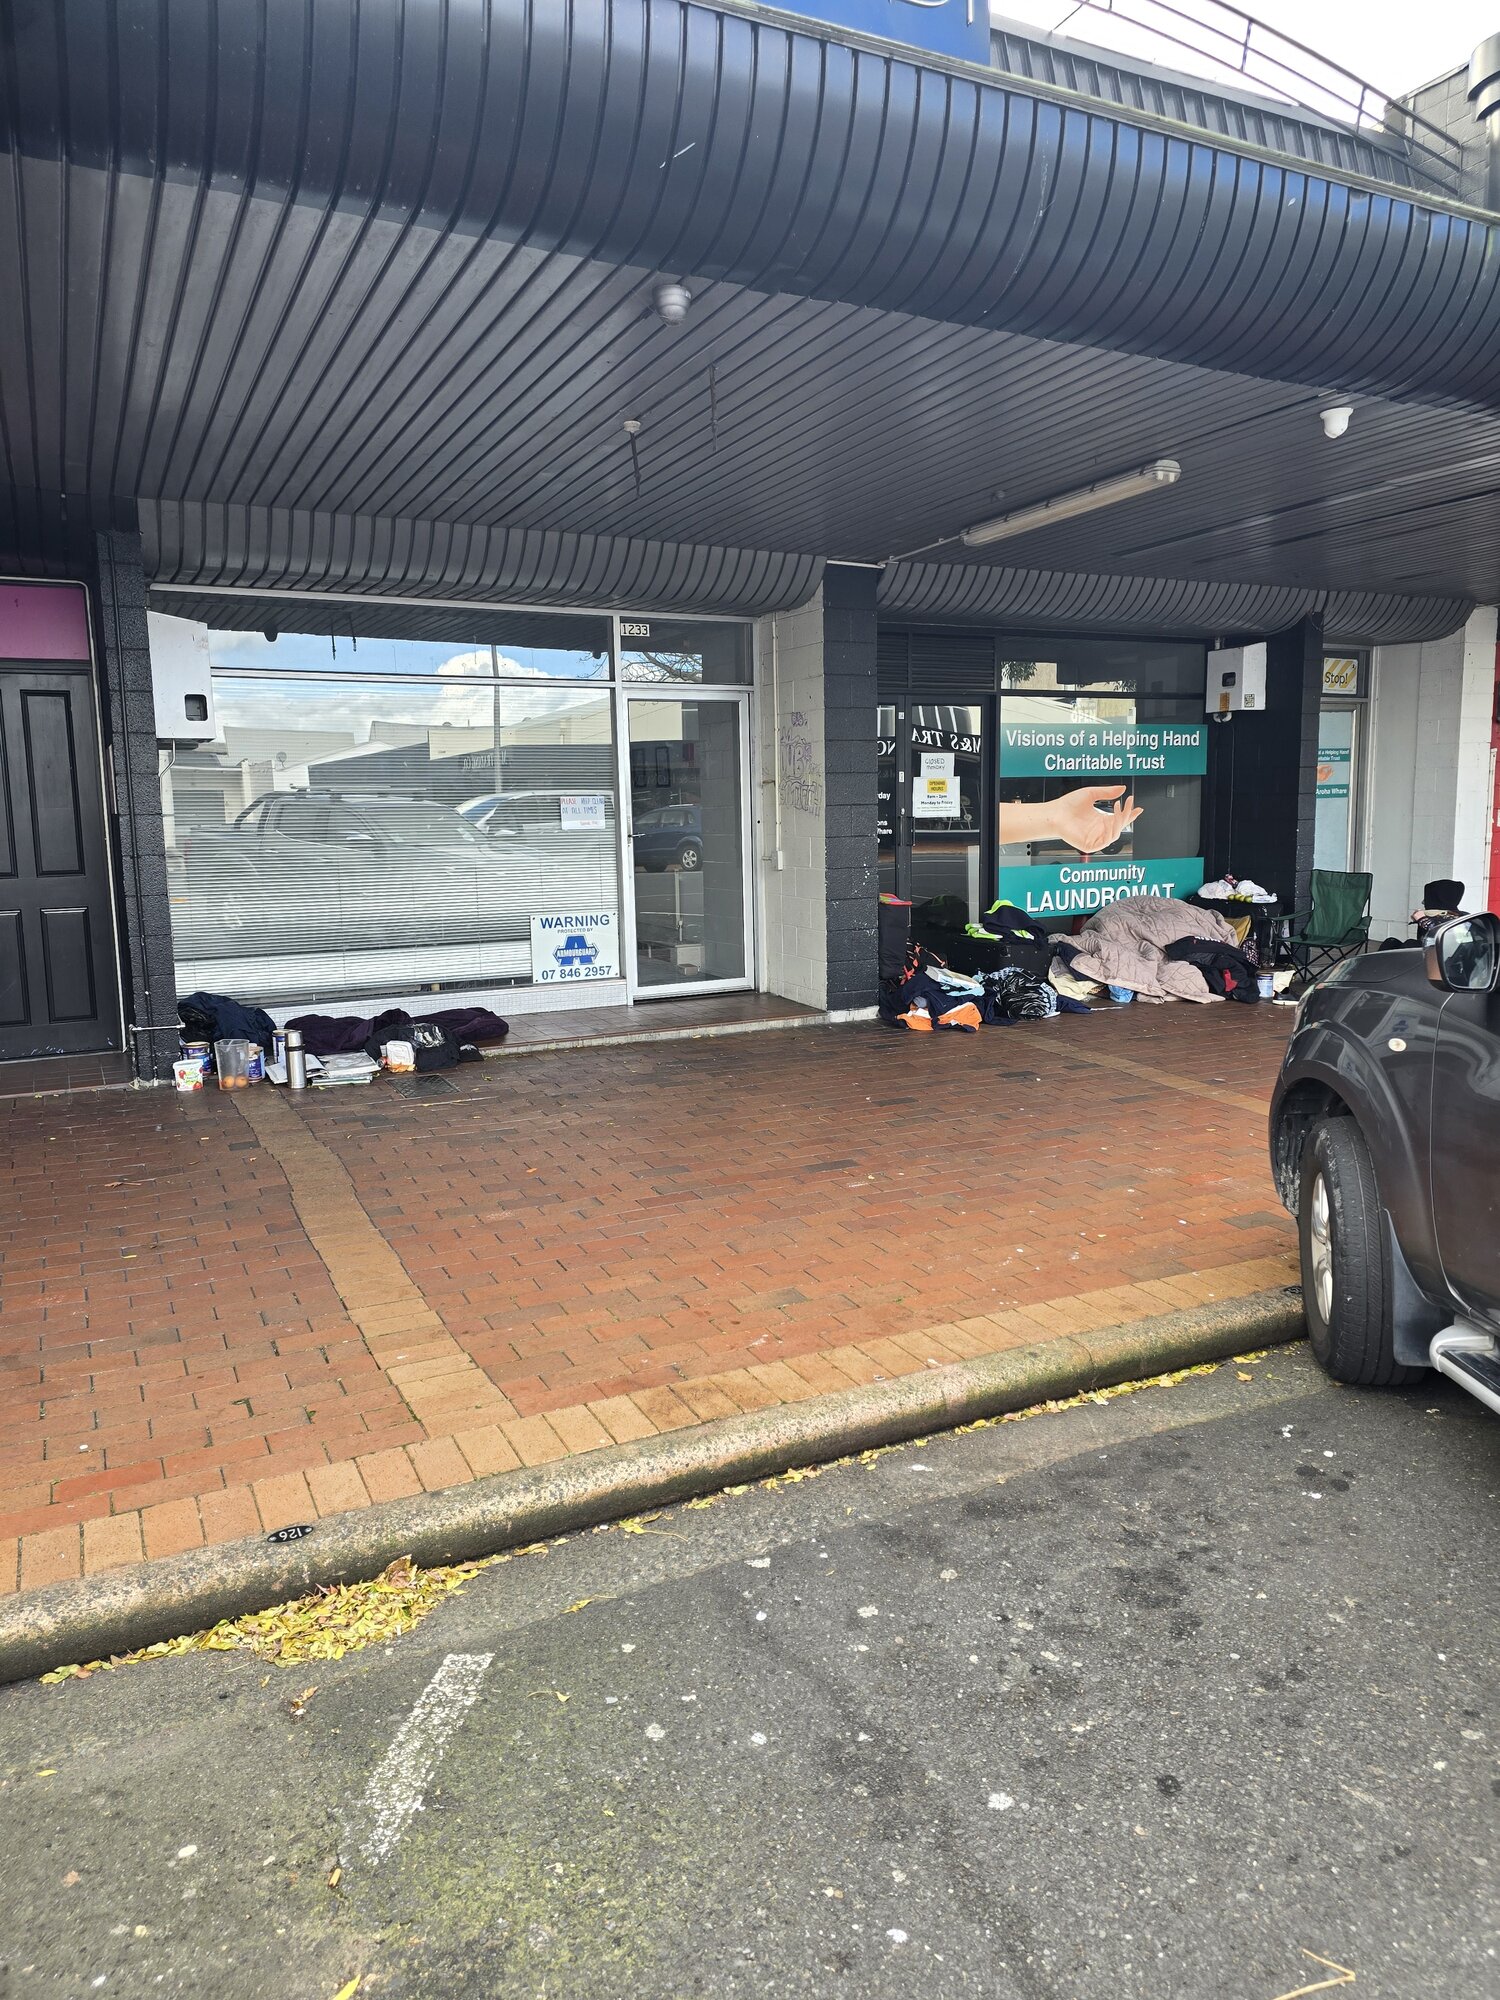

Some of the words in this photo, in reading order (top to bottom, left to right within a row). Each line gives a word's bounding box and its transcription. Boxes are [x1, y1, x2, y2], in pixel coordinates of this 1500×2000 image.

[622, 624, 648, 635] 1233
[1324, 671, 1348, 686] Stop!
[1006, 729, 1065, 747] Visions
[1069, 730, 1086, 747] of
[1089, 734, 1098, 747] a
[1102, 730, 1159, 751] Helping
[1163, 730, 1200, 747] Hand
[1044, 753, 1123, 771] Charitable
[1126, 753, 1165, 770] Trust
[1060, 864, 1146, 884] Community
[1026, 883, 1175, 913] LAUNDROMAT
[540, 914, 610, 929] WARNING
[541, 969, 556, 980] 07
[560, 967, 581, 979] 846
[584, 965, 612, 977] 2957
